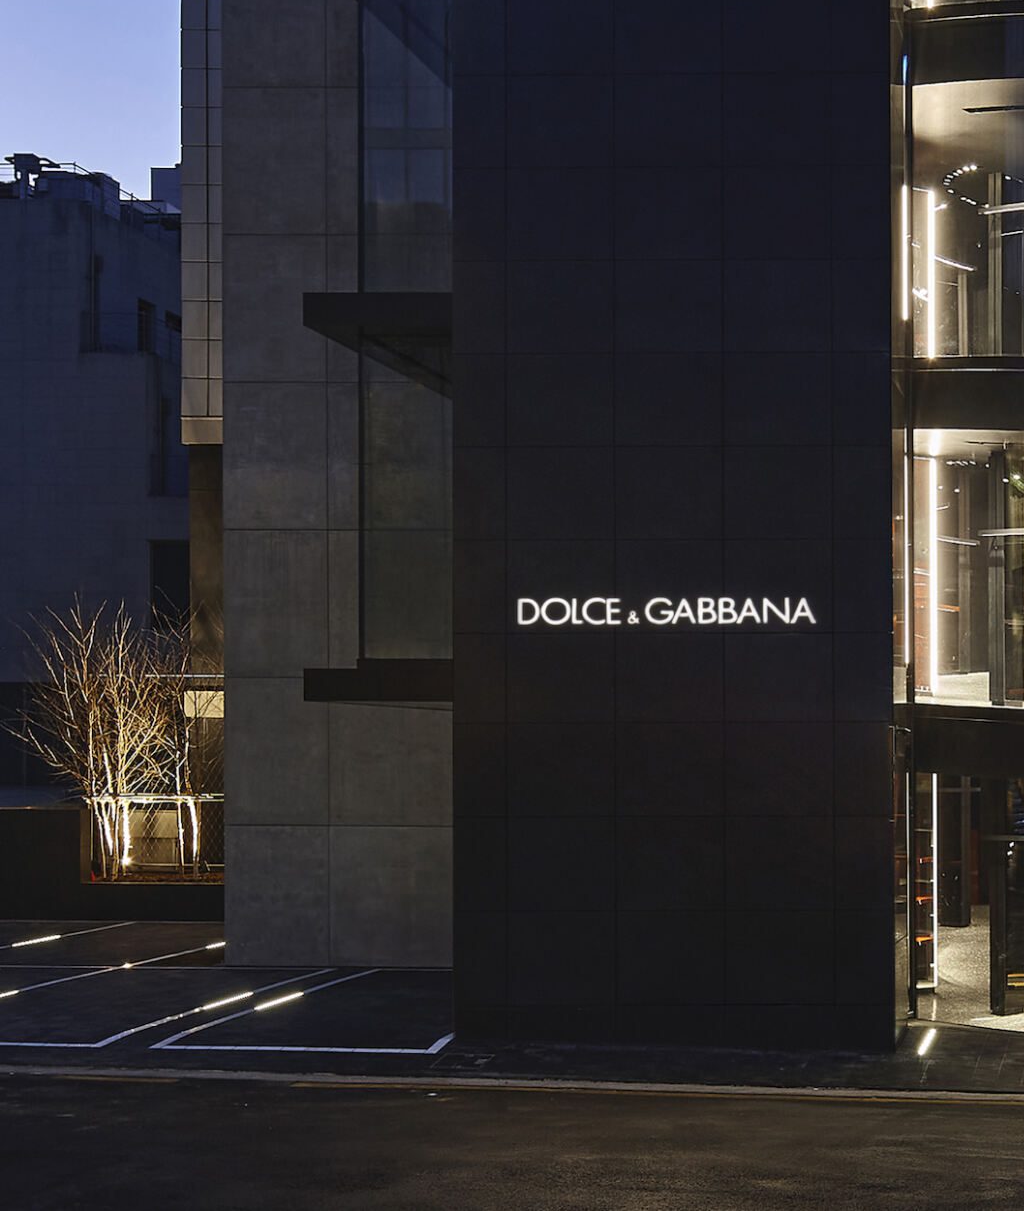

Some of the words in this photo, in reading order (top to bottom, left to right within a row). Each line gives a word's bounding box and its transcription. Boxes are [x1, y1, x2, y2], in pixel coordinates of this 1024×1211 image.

[516, 597, 621, 625] DOLCE
[626, 610, 640, 625] &
[644, 597, 817, 625] GABBANA
